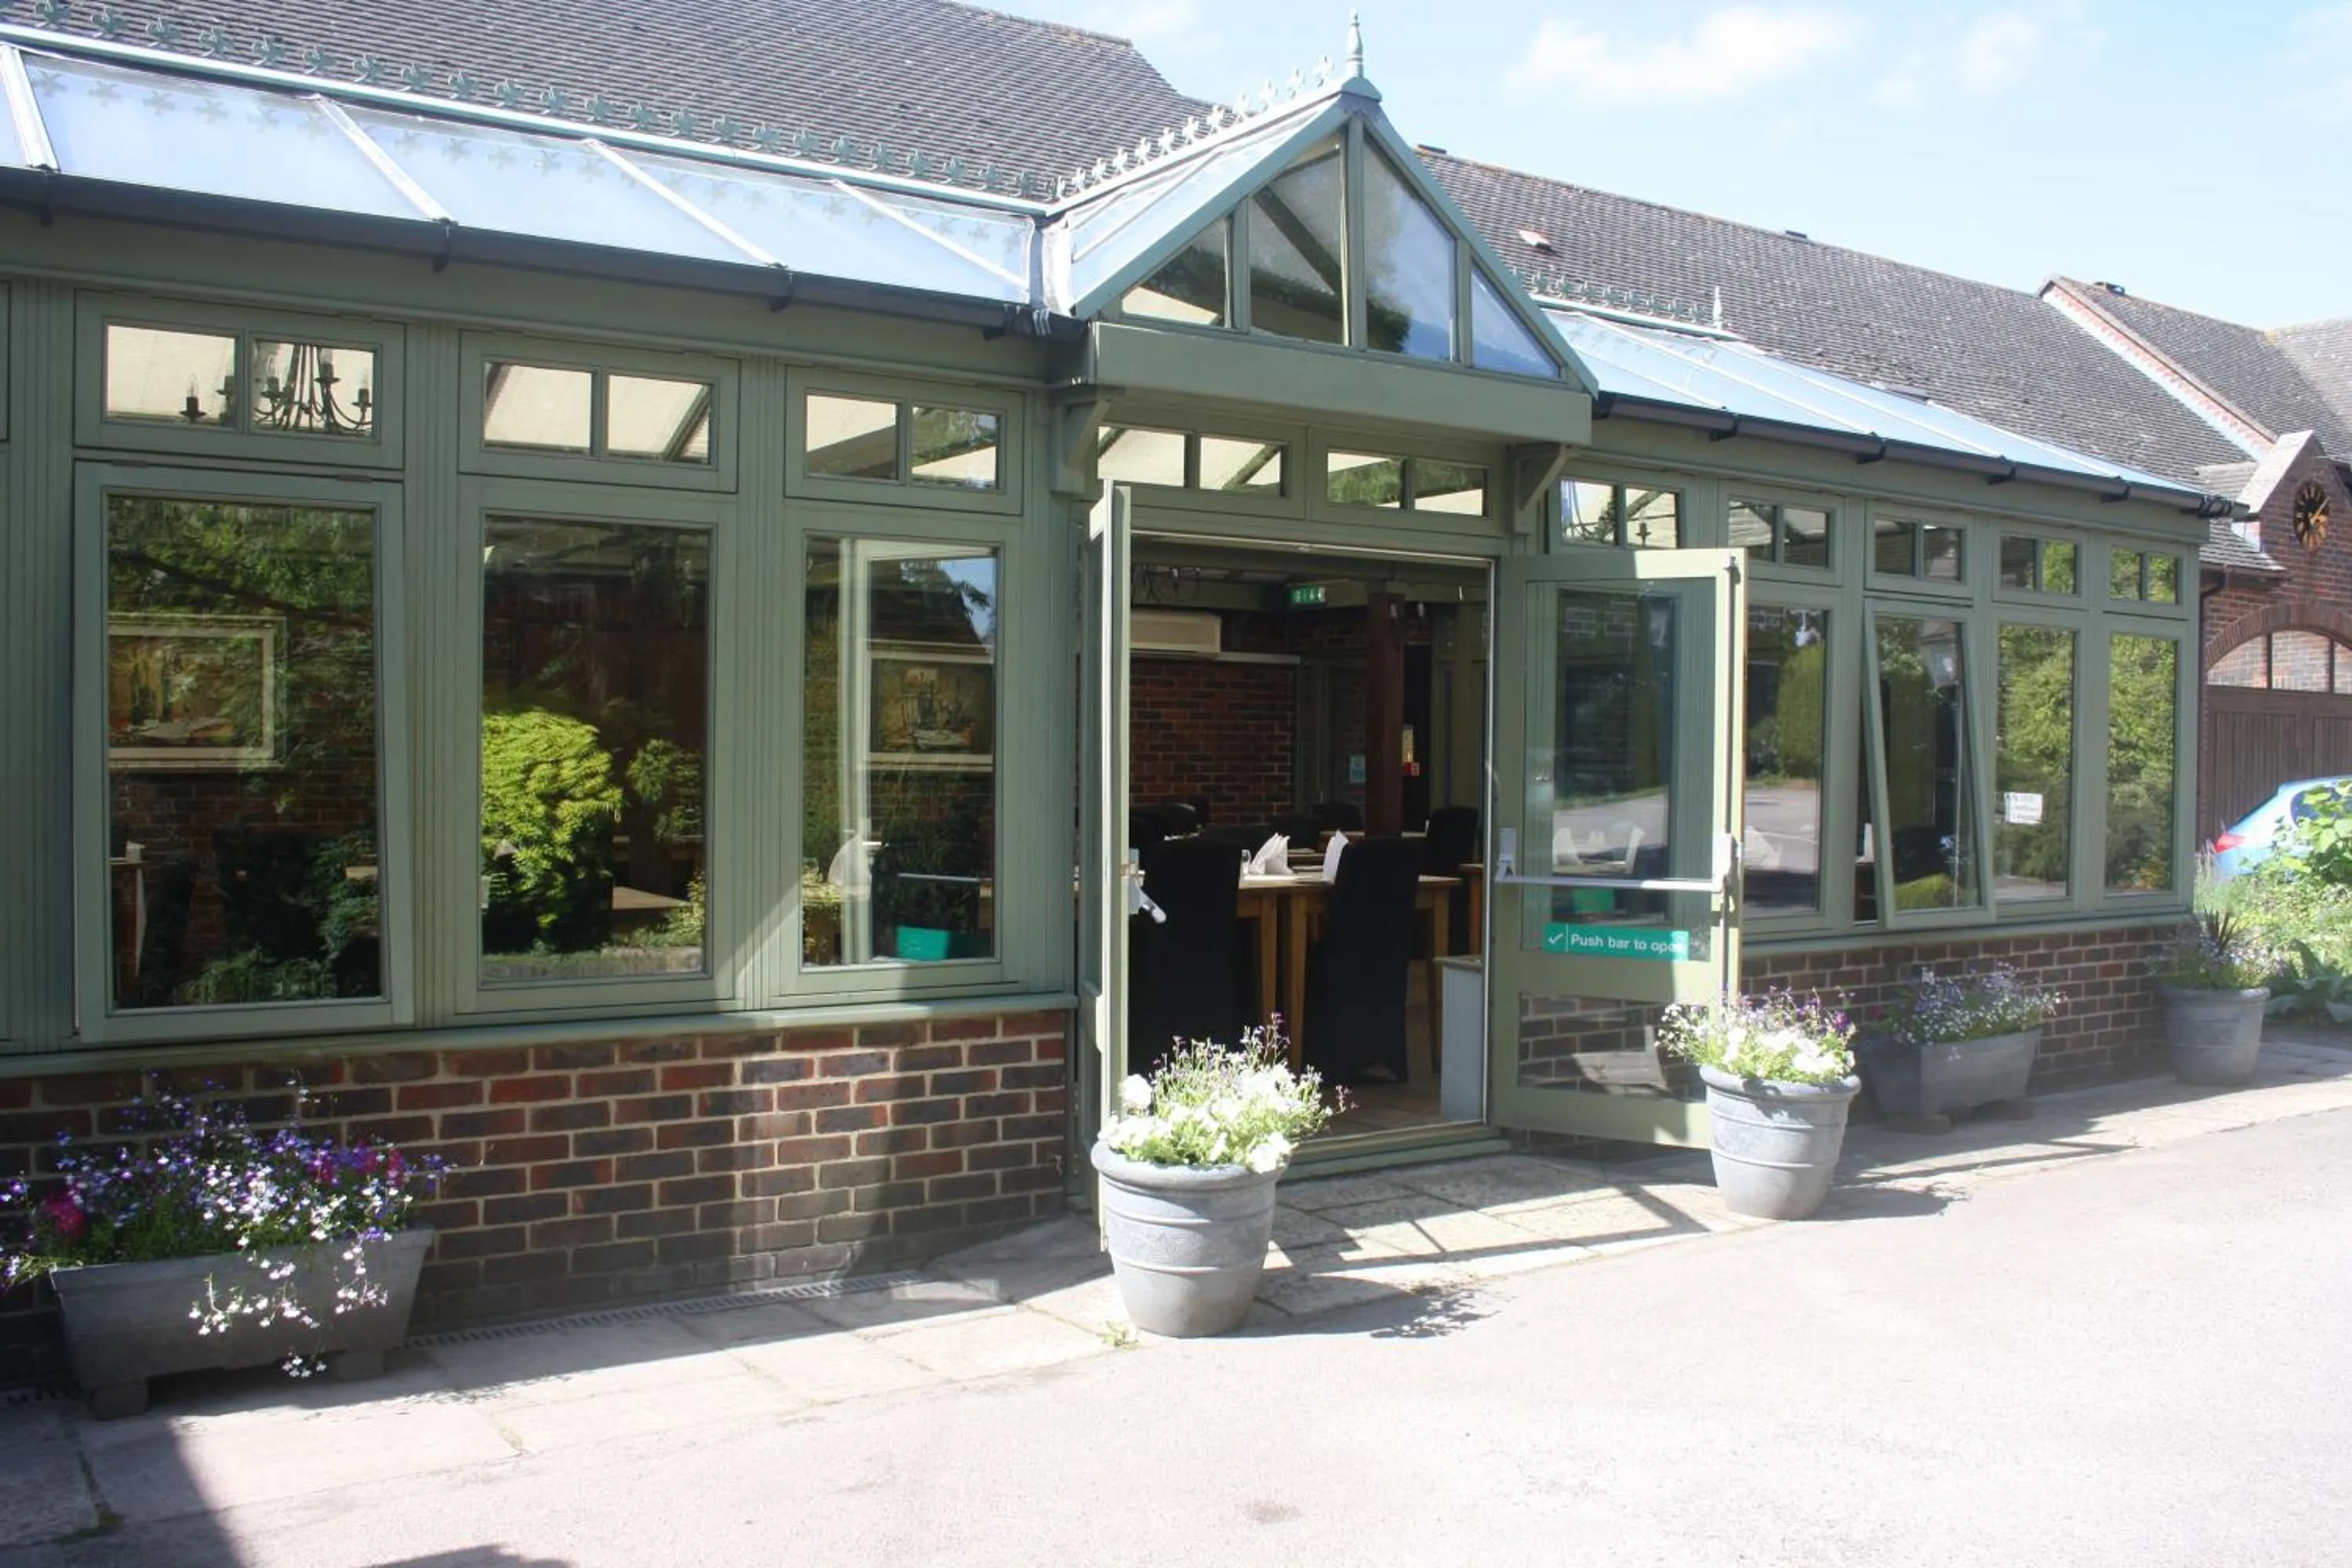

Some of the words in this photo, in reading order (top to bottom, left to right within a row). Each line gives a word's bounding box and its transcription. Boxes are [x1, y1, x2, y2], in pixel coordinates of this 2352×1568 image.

[1570, 933, 1604, 947] Push
[1608, 936, 1630, 949] bar
[1635, 939, 1647, 950] to
[1651, 941, 1686, 954] ope
